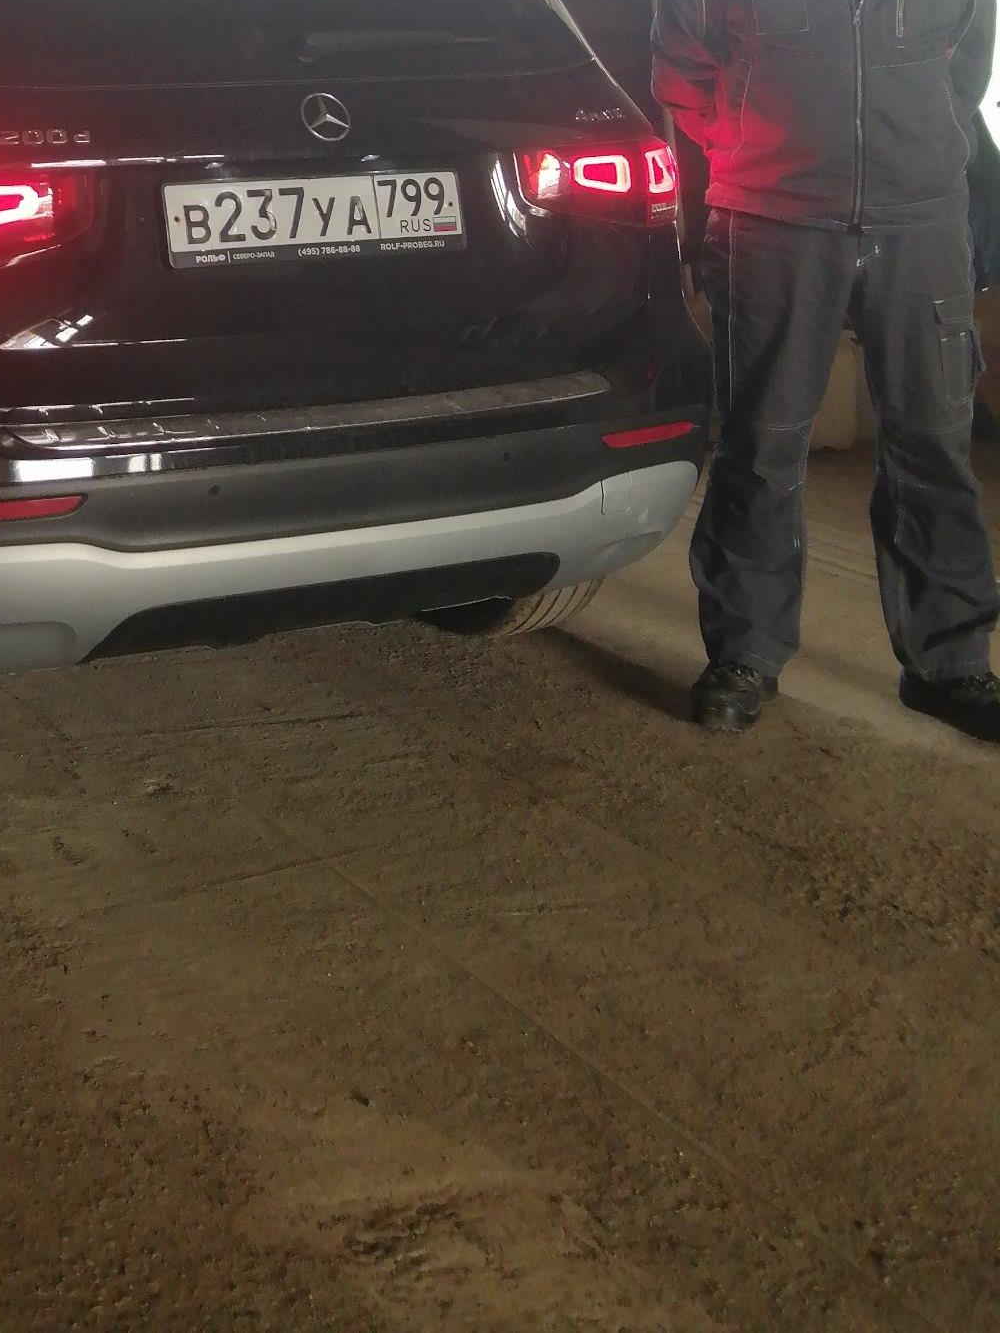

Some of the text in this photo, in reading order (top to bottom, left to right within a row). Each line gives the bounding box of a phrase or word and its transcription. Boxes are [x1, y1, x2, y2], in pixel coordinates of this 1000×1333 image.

[377, 177, 444, 217] 799
[400, 218, 432, 234] RUS
[195, 253, 226, 264] РОЛЬФ
[298, 247, 320, 257] (495)
[380, 240, 445, 251] ROLF-PROBEG.RU
